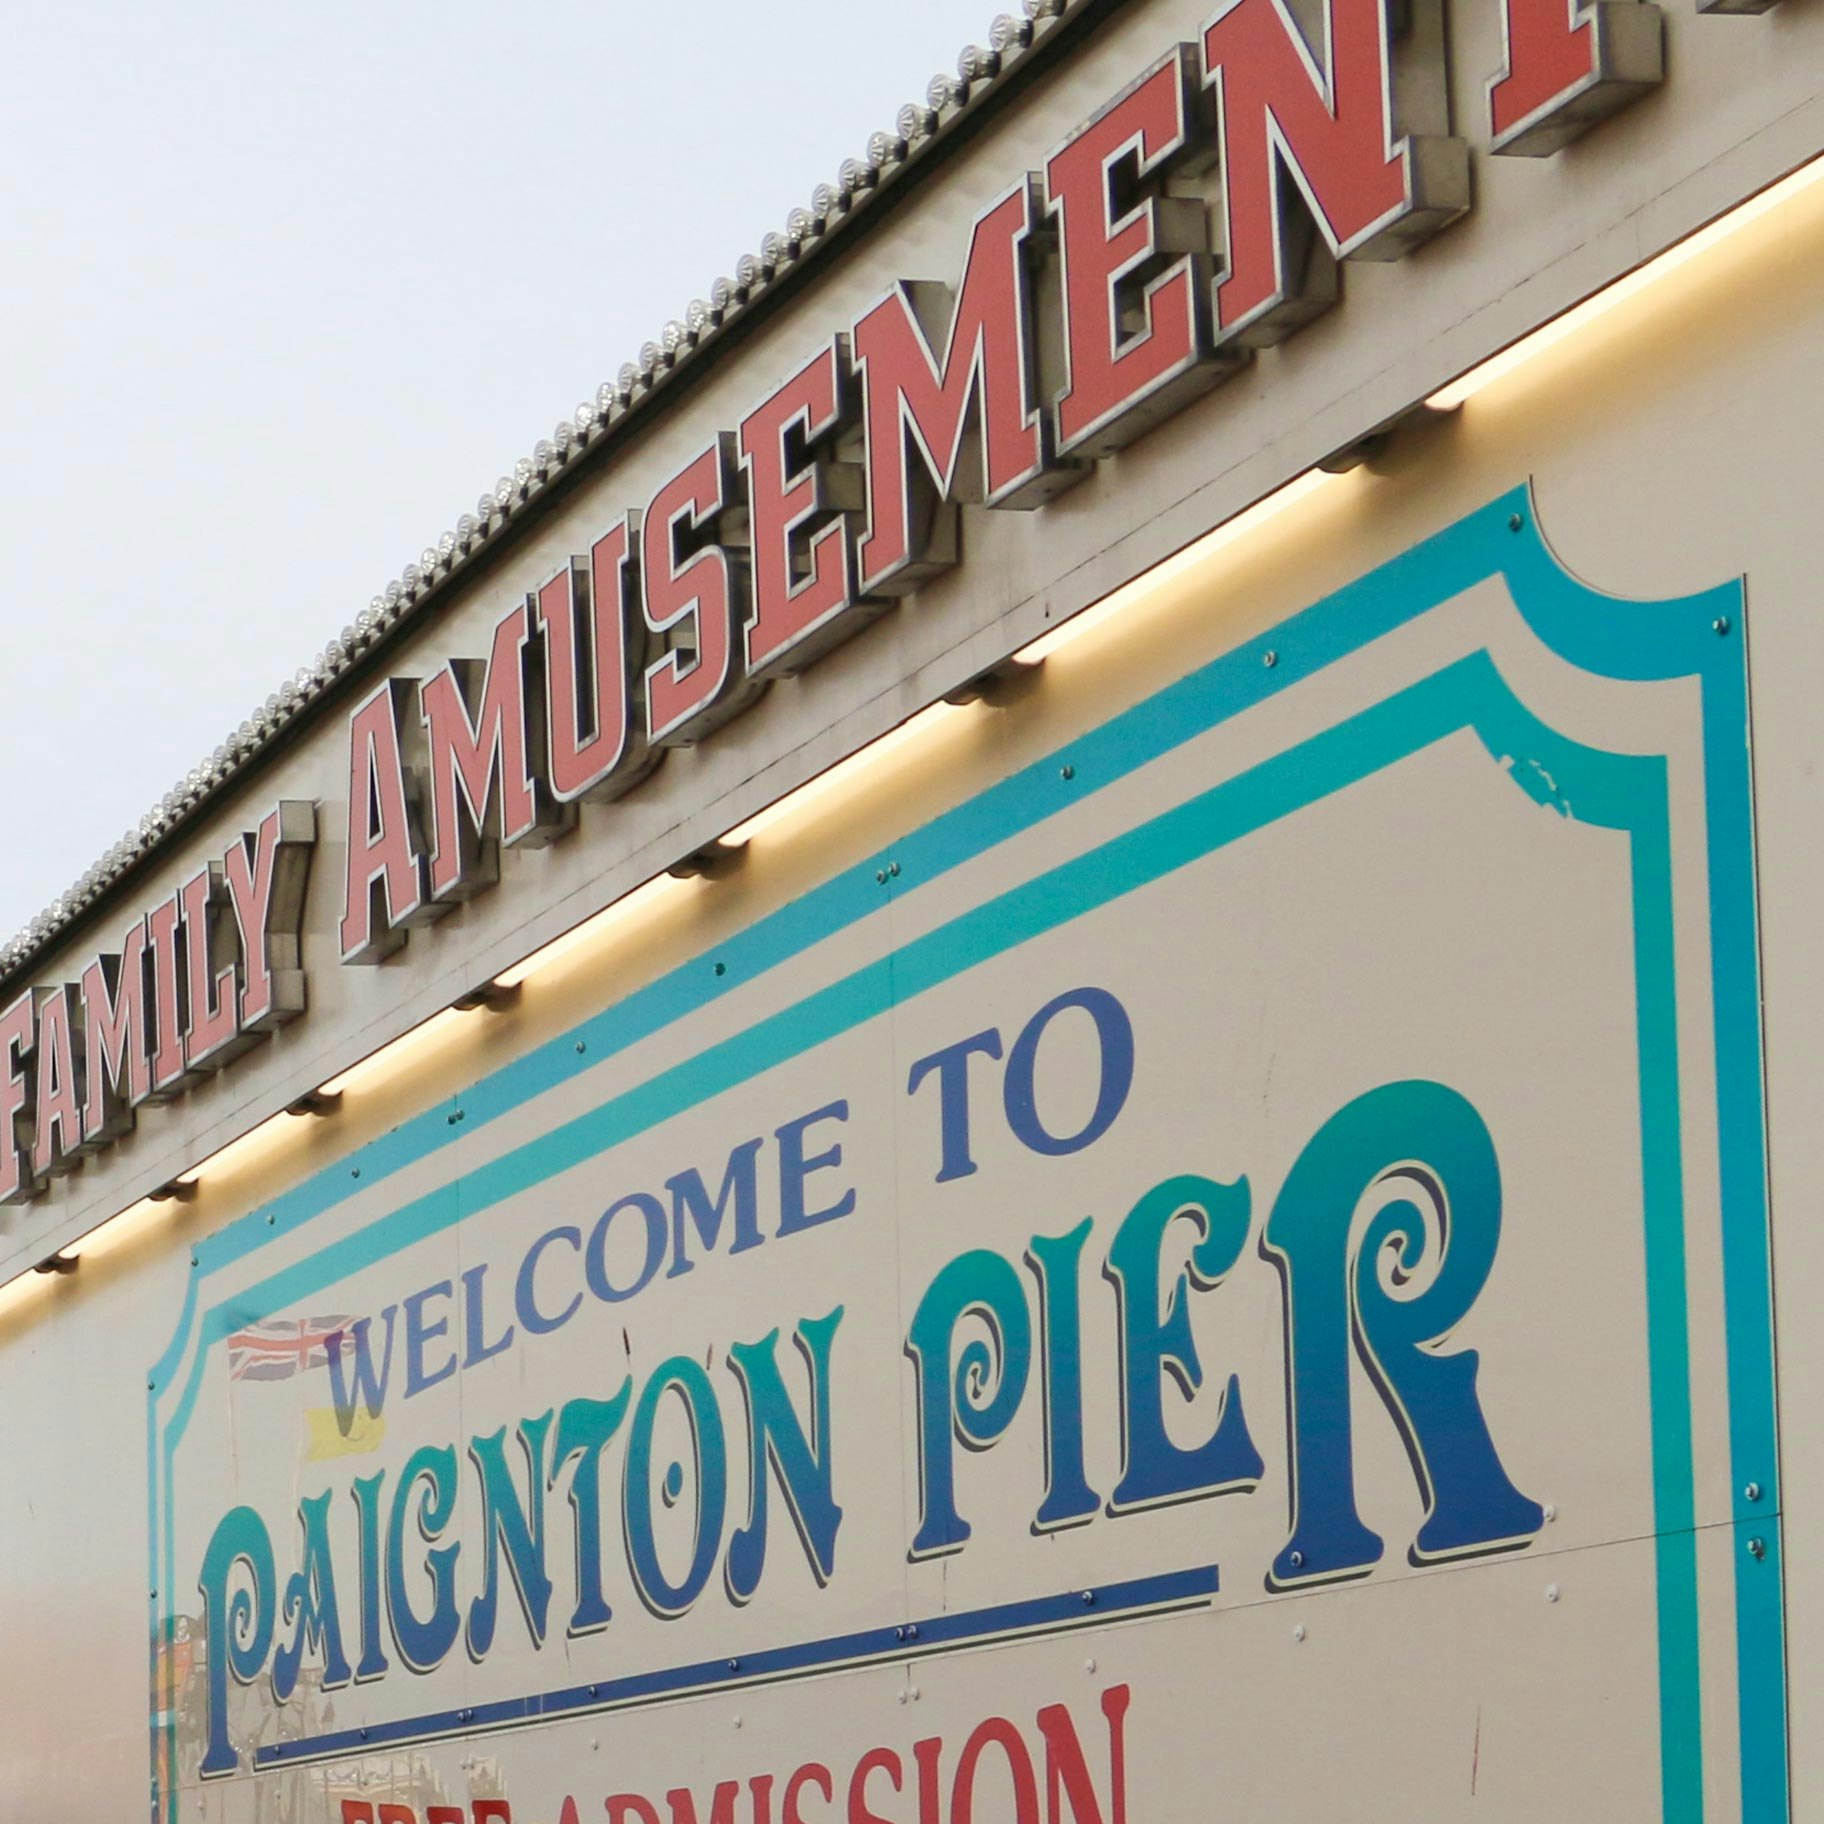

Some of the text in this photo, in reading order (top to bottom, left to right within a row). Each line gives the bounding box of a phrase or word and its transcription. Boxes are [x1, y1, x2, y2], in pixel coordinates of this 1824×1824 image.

[197, 1076, 1548, 1780] PAIGNTON PIER
[321, 984, 1135, 1434] WELCOME TO
